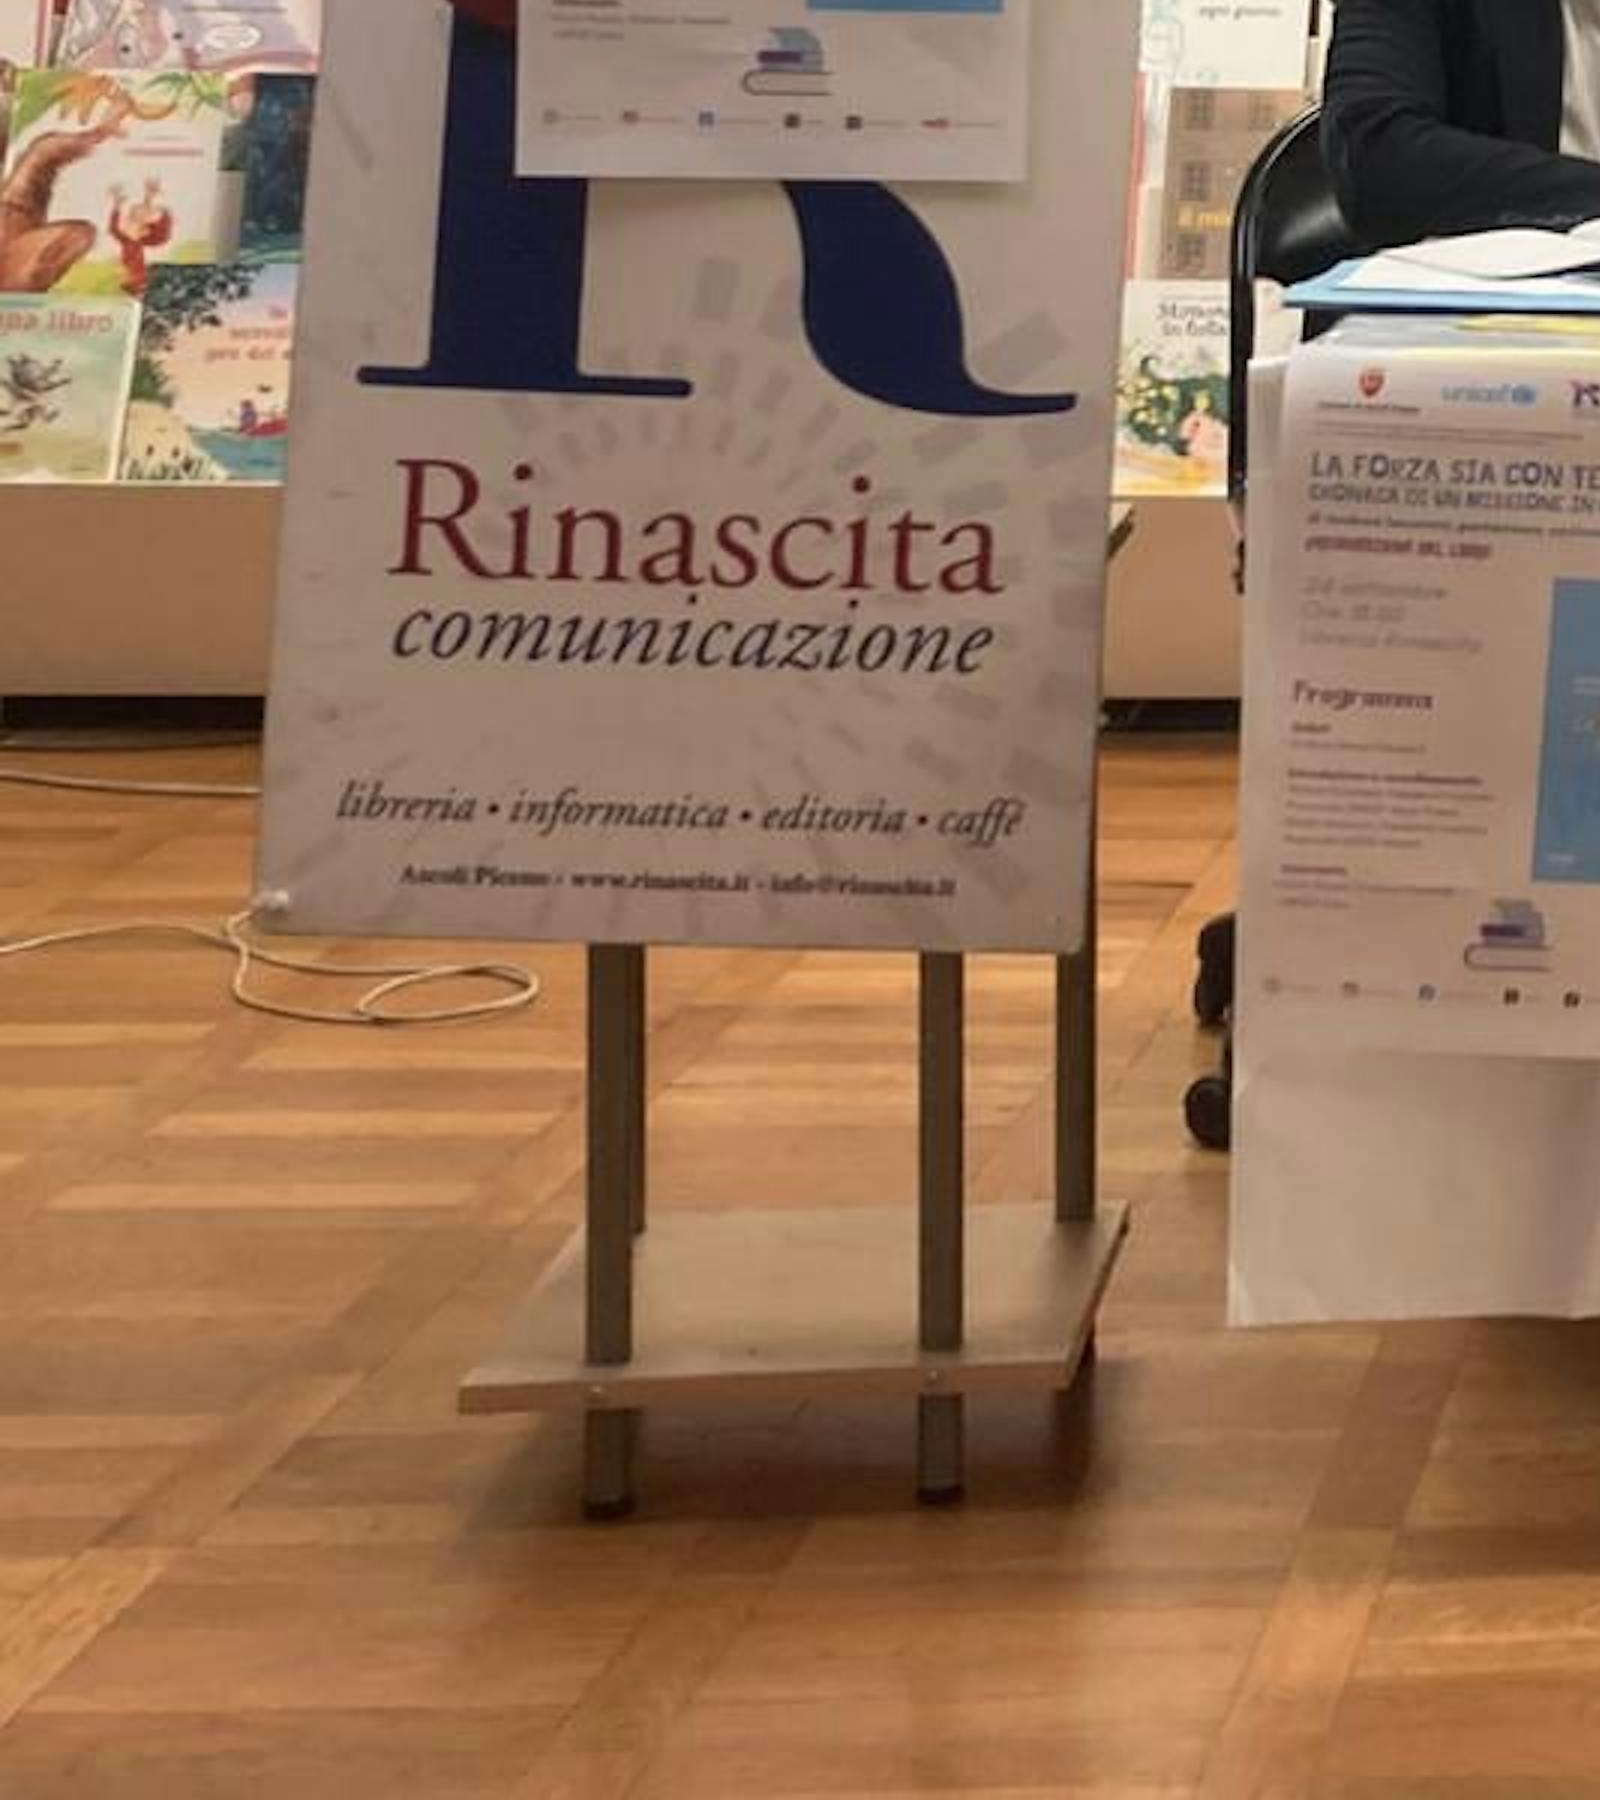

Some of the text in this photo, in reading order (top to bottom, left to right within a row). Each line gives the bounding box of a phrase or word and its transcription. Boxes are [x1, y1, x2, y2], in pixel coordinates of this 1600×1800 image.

[1311, 452, 1343, 478] LA
[1353, 453, 1441, 482] FORZA
[1450, 459, 1496, 484] SIA
[1505, 462, 1564, 488] CON
[388, 459, 1007, 595] Rinascita
[1572, 495, 1596, 514] IN
[391, 596, 996, 679] comunicazione
[1293, 680, 1434, 711] Programma
[335, 779, 478, 823] libreria
[509, 786, 730, 838] informatica
[761, 794, 910, 834] editoria
